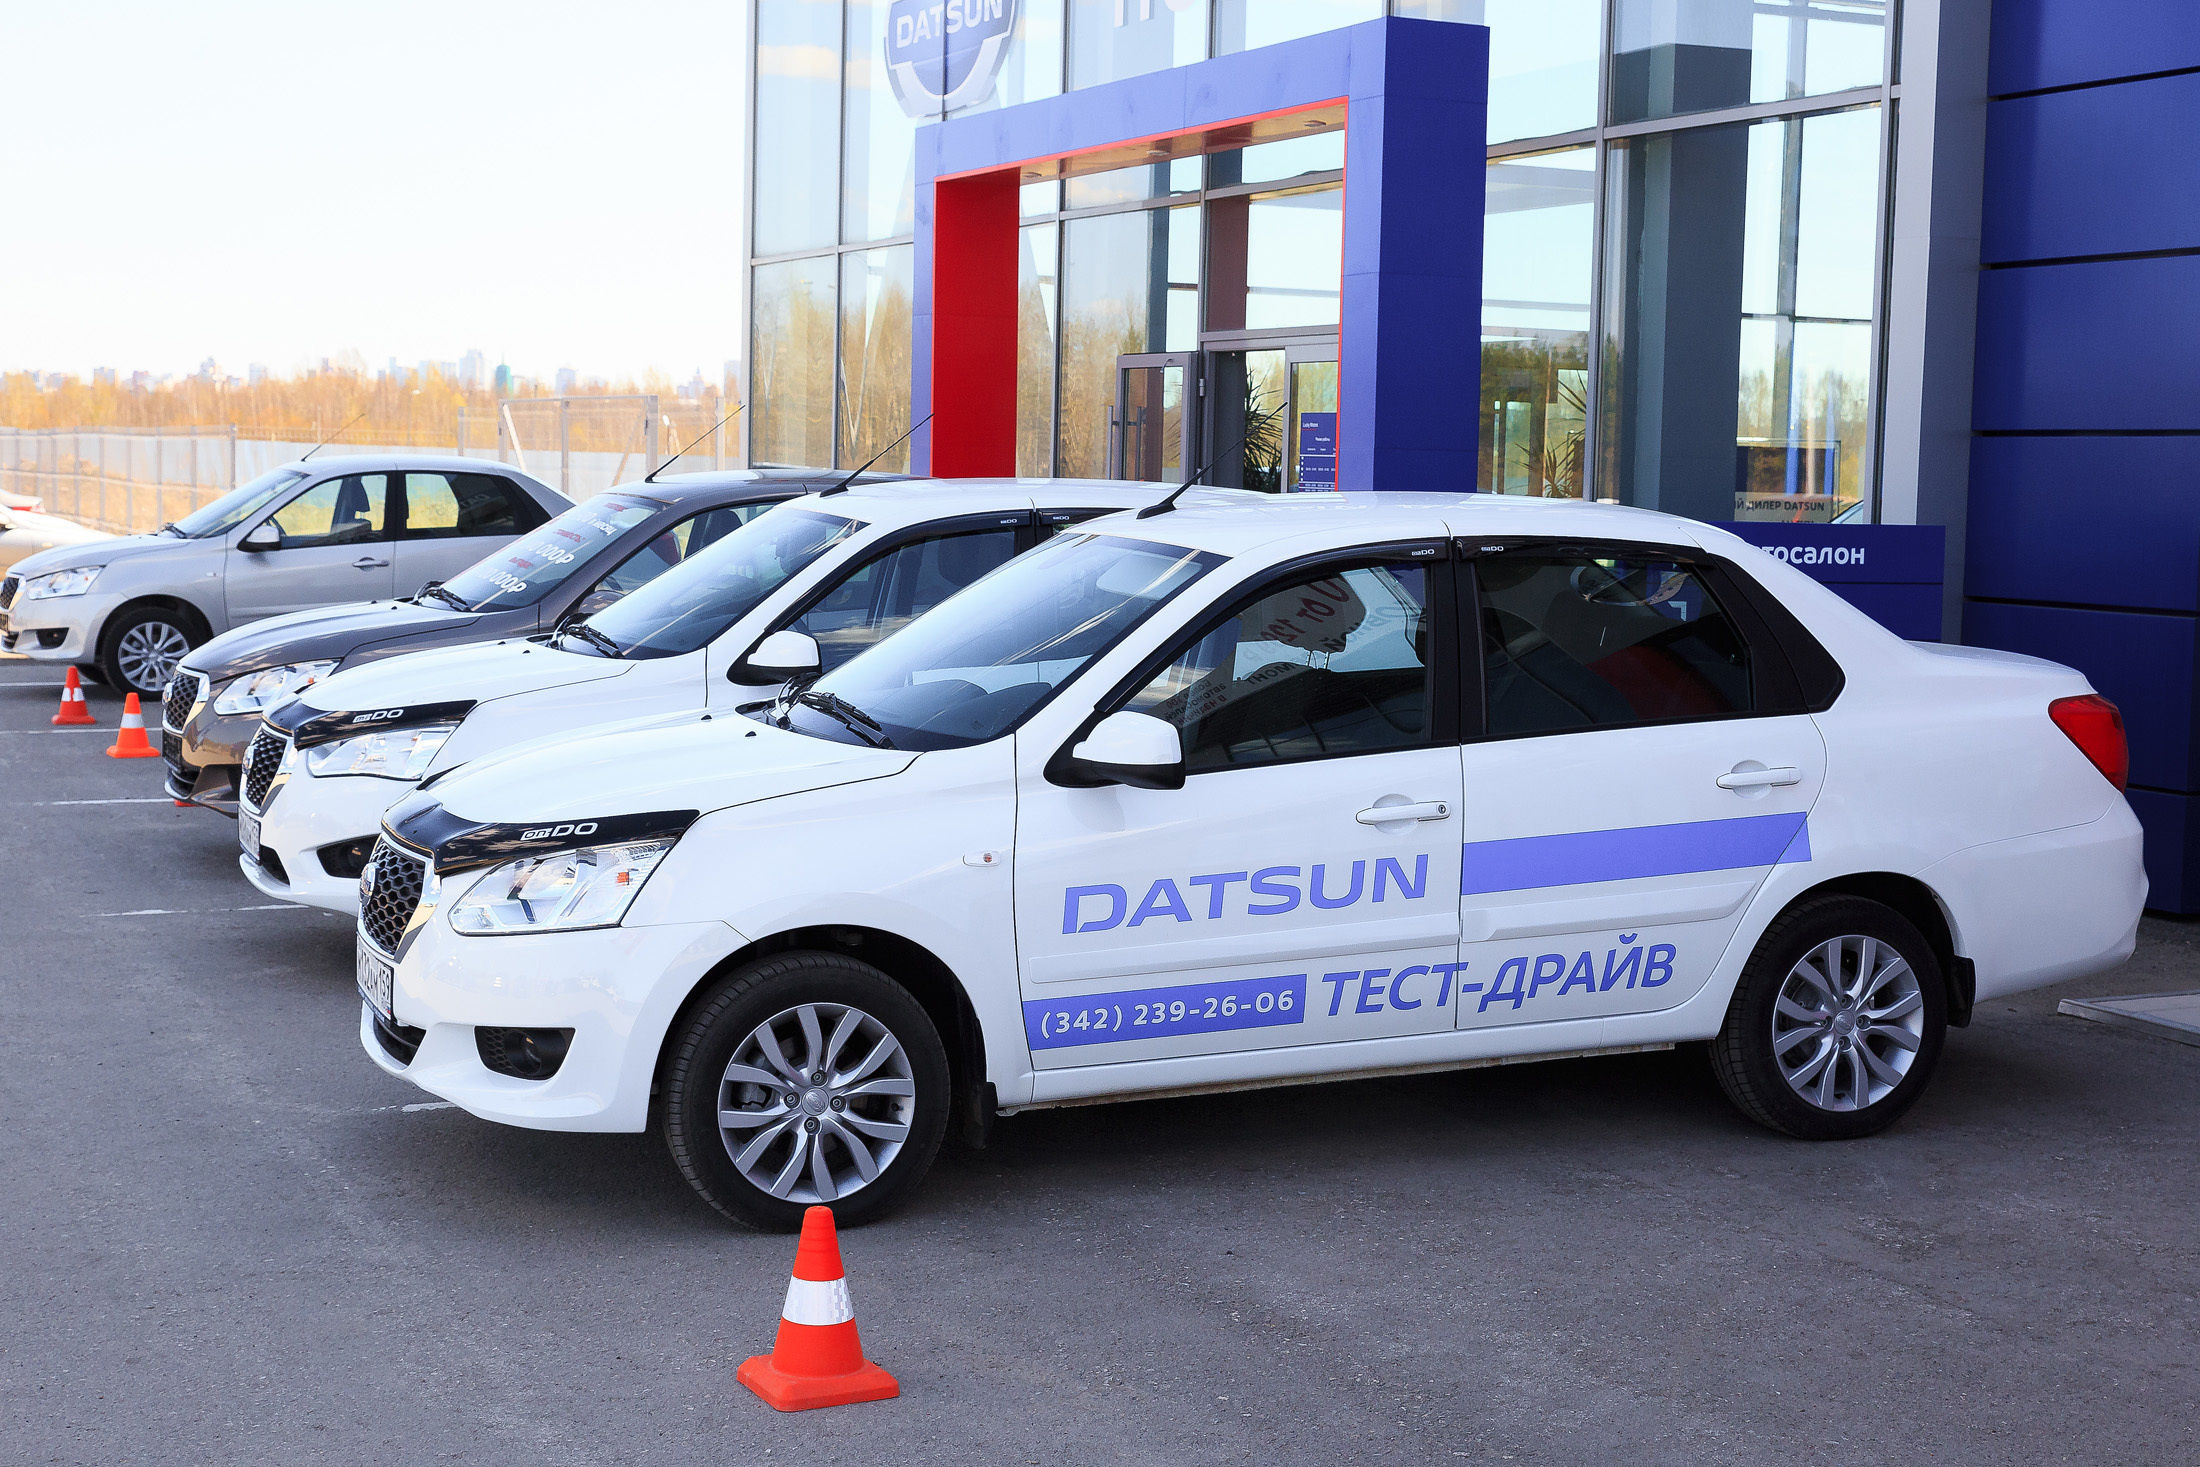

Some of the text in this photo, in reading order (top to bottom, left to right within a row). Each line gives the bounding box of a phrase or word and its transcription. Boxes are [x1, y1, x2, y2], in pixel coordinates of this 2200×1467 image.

[895, 0, 1005, 48] DATSUN
[1746, 501, 1782, 511] ДИЛЕР
[1783, 501, 1825, 511] DATSUN
[1757, 546, 1865, 565] тосалон
[520, 822, 599, 841] onDO
[1062, 854, 1429, 935] DATSUN
[1321, 932, 1677, 1018] ТЕСТ-ДРАЙВ
[1040, 989, 1295, 1041] (342) 239-26-06
